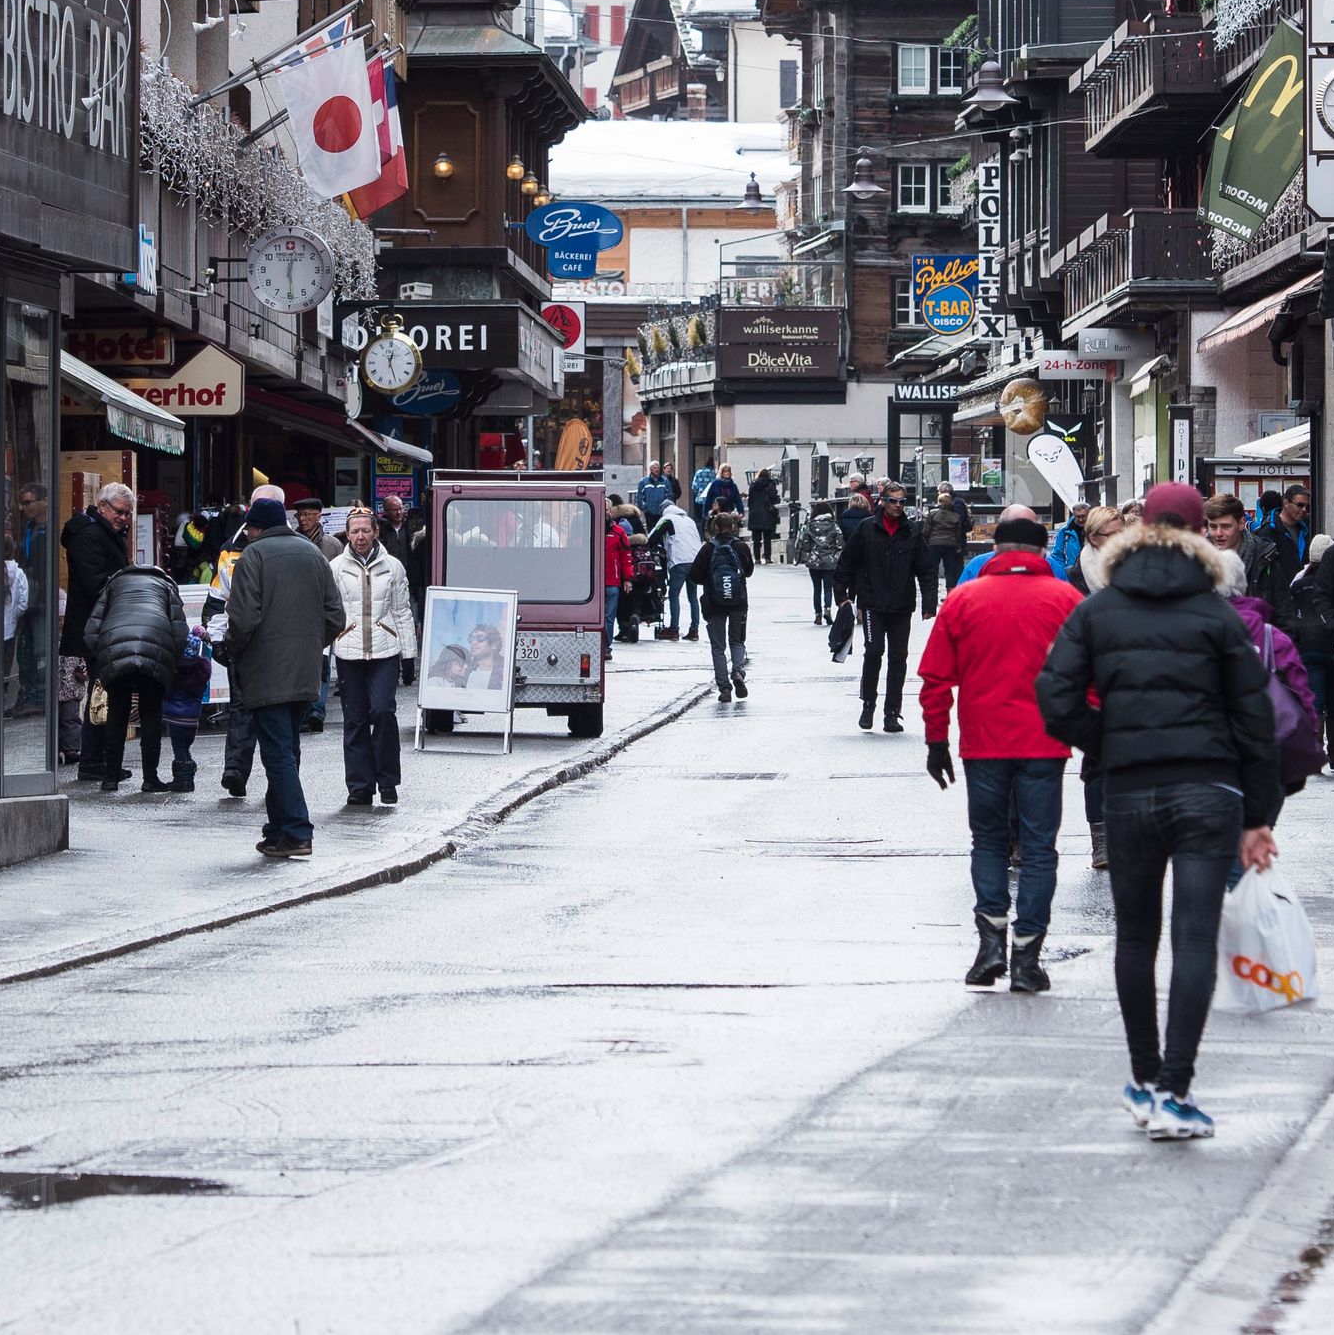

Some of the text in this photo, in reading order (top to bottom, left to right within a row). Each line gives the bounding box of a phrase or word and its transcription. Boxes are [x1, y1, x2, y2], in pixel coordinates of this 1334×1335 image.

[89, 19, 128, 159] BAR
[554, 251, 592, 261] BÄCKEREI
[980, 165, 1005, 339] POLLUX
[562, 263, 583, 272] CAFÉ
[916, 259, 980, 295] Pollux
[926, 300, 971, 317] T-BAR
[933, 318, 964, 326] DISCO
[743, 325, 819, 334] walliserkanne
[67, 332, 166, 362] Hotel
[1044, 359, 1107, 371] 24-h-Zone
[1259, 466, 1295, 475] HOTEL
